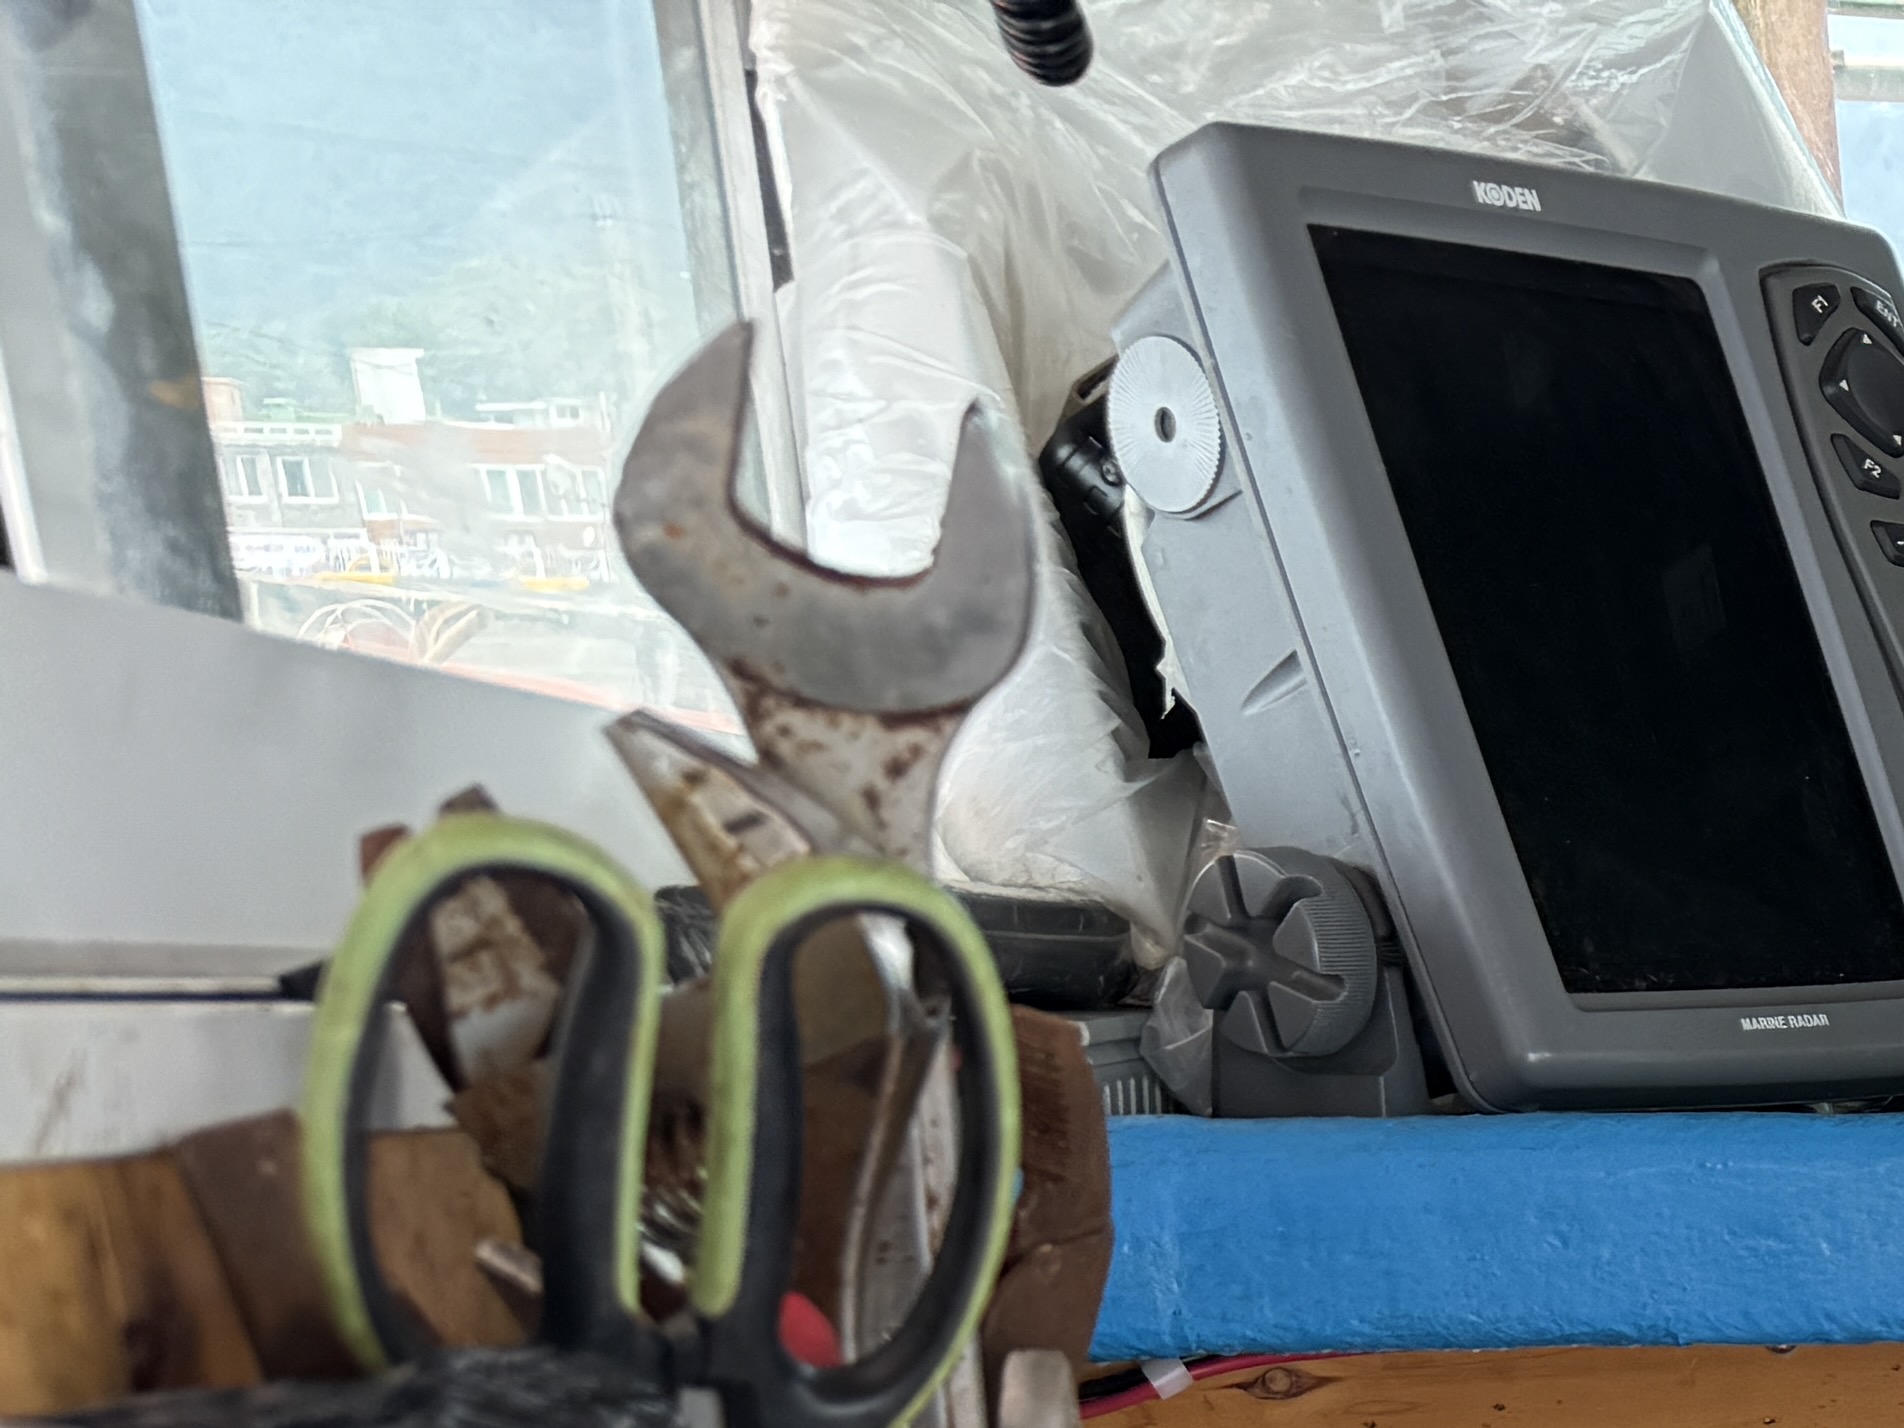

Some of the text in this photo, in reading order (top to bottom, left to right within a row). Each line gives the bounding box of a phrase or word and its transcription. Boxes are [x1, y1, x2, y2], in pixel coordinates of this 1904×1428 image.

[1473, 180, 1542, 212] KODEN
[1811, 295, 1829, 314] F1
[1862, 457, 1882, 478] F2
[1739, 1014, 1831, 1033] MARINE RADAR
